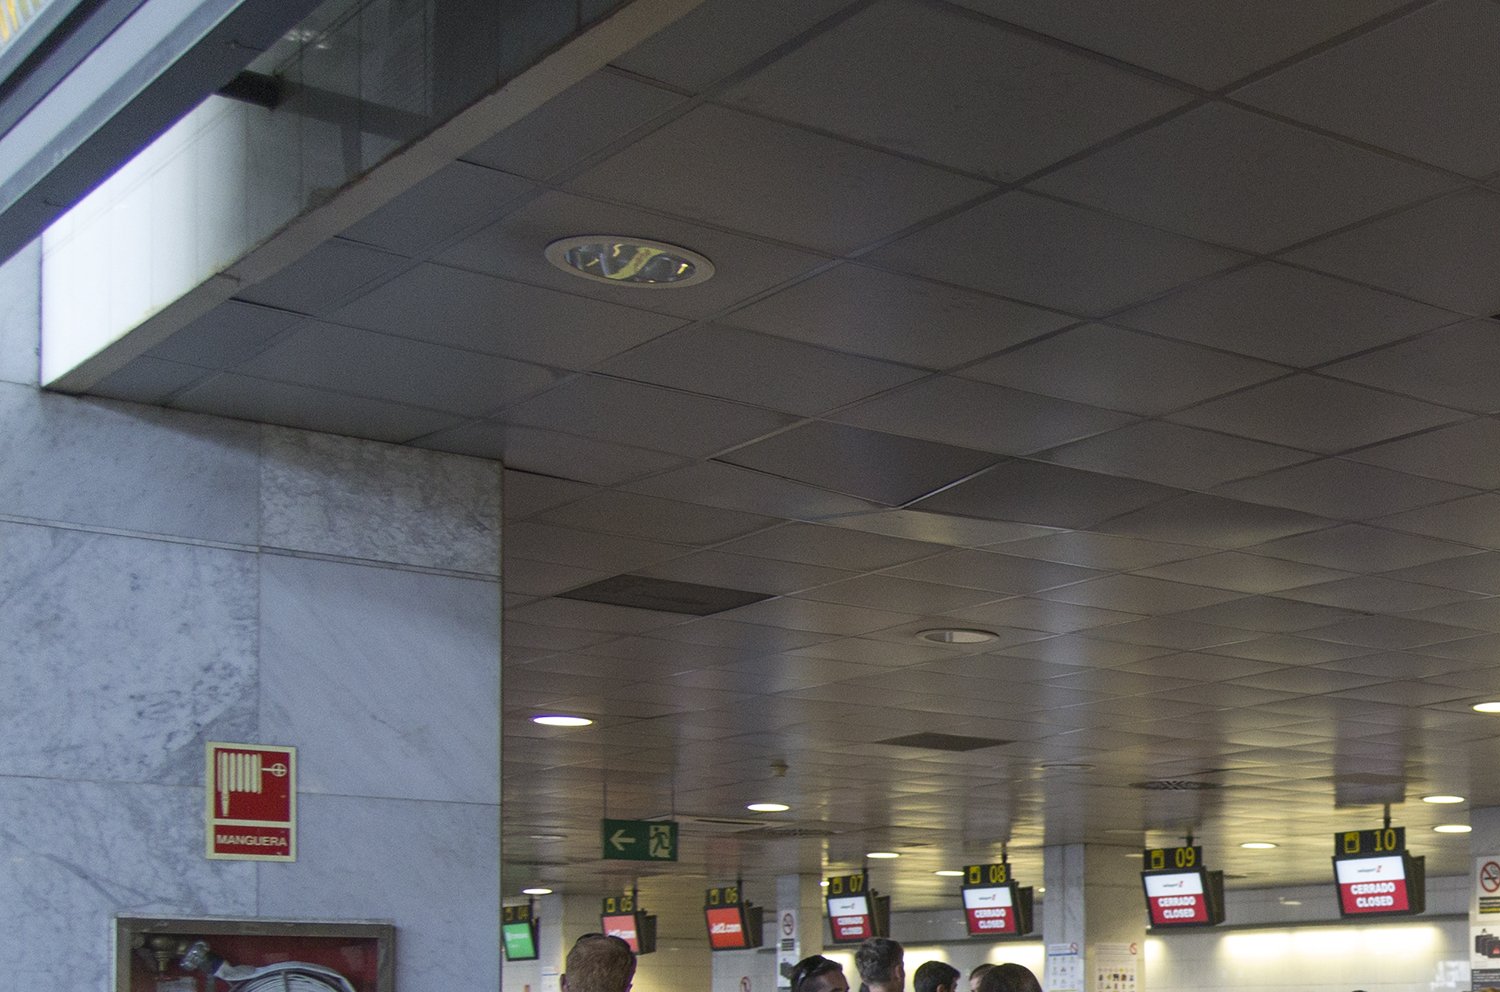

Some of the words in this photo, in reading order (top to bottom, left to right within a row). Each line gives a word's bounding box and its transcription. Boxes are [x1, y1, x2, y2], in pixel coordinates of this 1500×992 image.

[216, 834, 288, 847] MANGUERA
[1373, 828, 1397, 852] 10
[1174, 847, 1196, 868] 09
[989, 865, 1007, 883] 08
[849, 876, 864, 893] 07
[1350, 881, 1397, 896] CERRADO
[1158, 895, 1197, 908] CERRADO
[1355, 895, 1395, 909] CLOSED
[1162, 907, 1196, 919] CLOSED
